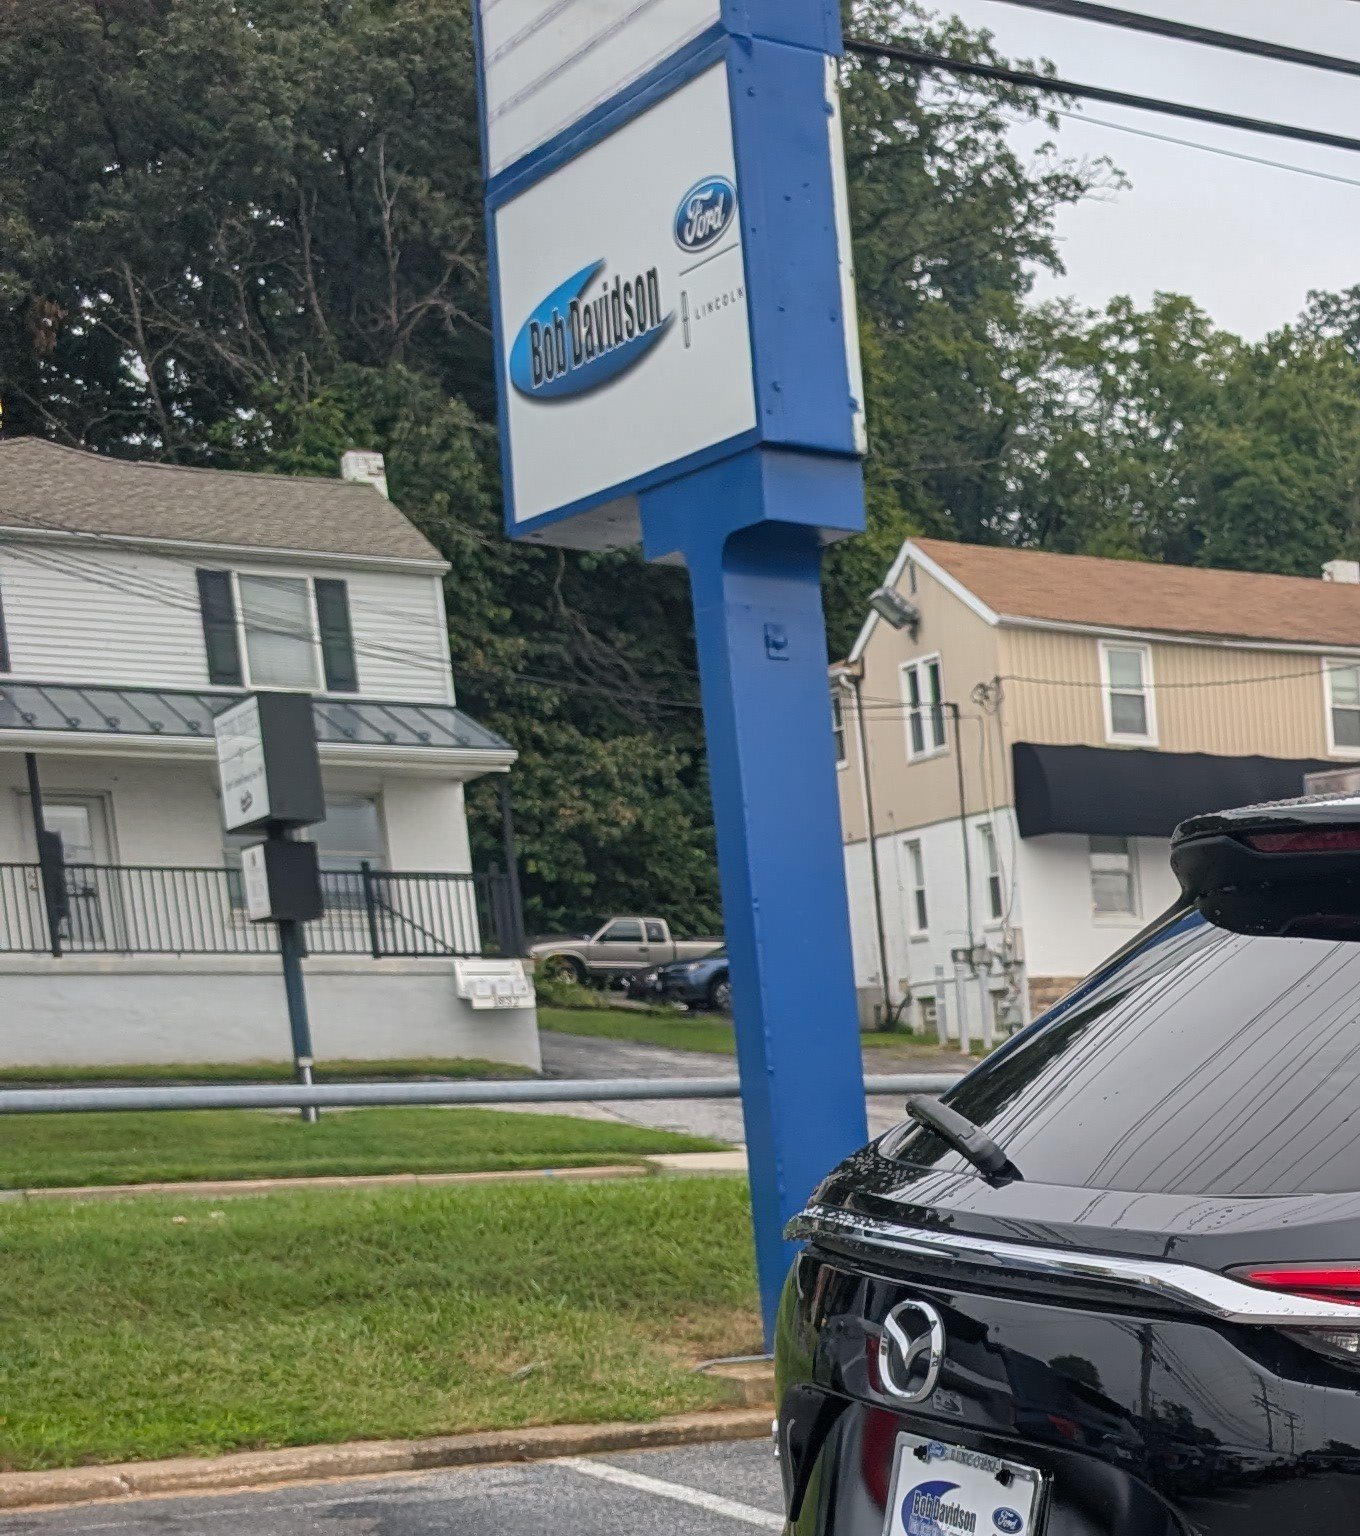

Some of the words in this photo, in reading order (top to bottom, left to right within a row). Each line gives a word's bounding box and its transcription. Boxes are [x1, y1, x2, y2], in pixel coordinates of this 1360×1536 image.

[684, 187, 727, 245] Ford
[530, 308, 568, 388] Bob
[568, 265, 662, 369] Davidson
[693, 285, 745, 321] LINCOLN
[912, 1490, 933, 1519] Bob
[932, 1496, 977, 1533] Davidson
